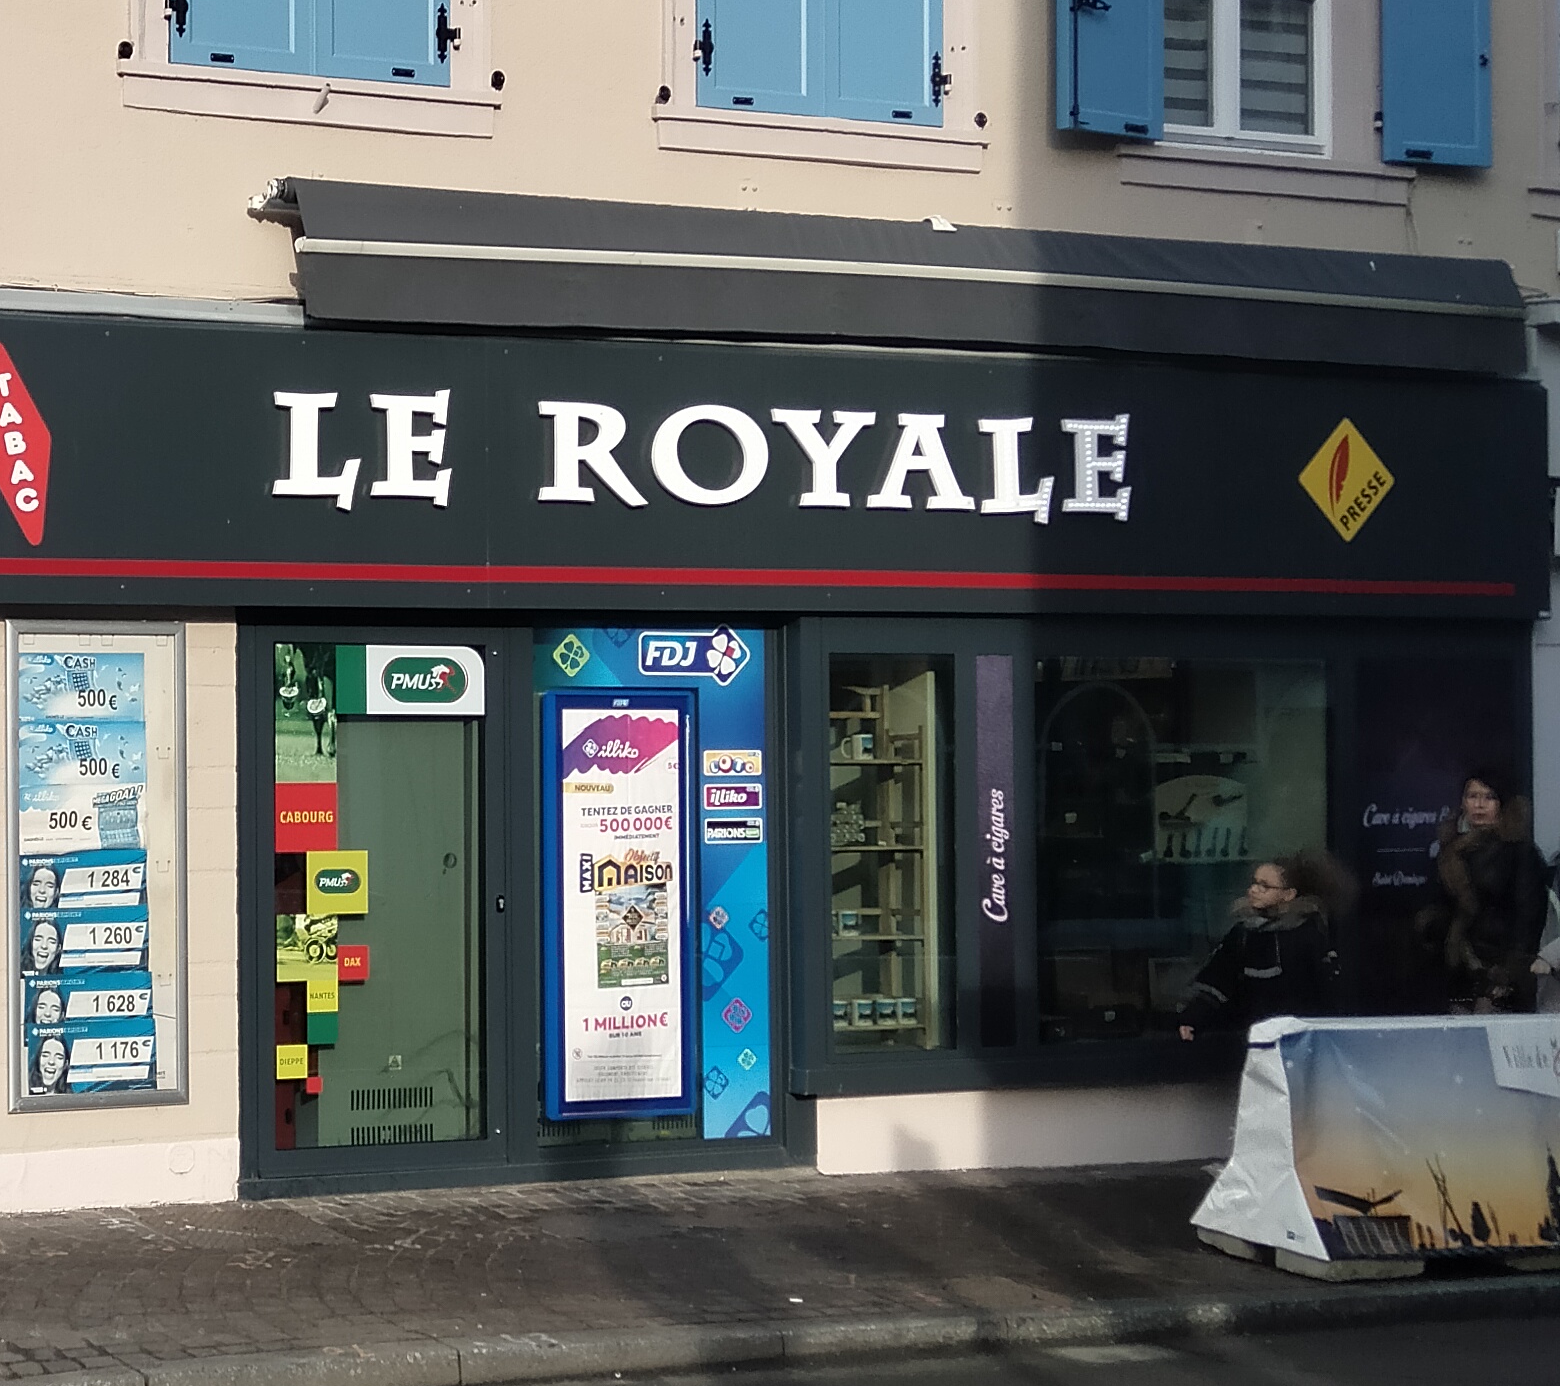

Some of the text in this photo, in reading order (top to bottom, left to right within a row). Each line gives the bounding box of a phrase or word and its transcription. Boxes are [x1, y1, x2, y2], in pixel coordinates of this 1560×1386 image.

[272, 388, 1133, 524] LE ROYALE
[1339, 471, 1387, 531] PRESSE
[645, 640, 698, 666] FDJ
[63, 655, 96, 669] CASH
[390, 673, 430, 690] PMU
[78, 689, 118, 710] 500 €
[65, 724, 98, 737] CASH
[598, 739, 639, 758] illiko
[79, 758, 120, 778] 500 €
[575, 784, 611, 792] NOUVEAU
[710, 789, 748, 805] illiko
[280, 811, 334, 823] CABOURG
[581, 804, 673, 816] TENTEZ DE GAGNER
[49, 811, 92, 830] 500 €
[985, 788, 1010, 853] cigares
[707, 827, 746, 839] PARIONS
[87, 871, 95, 888] 1
[101, 870, 130, 887] 284
[582, 855, 592, 891] MAXI
[319, 877, 340, 887] PMU
[982, 874, 1008, 922] Cave
[89, 927, 97, 945] 1
[103, 926, 132, 945] 260
[344, 957, 361, 967] DAX
[92, 995, 100, 1013] 1
[106, 994, 135, 1013] 628
[310, 992, 335, 1000] NANTES
[621, 1000, 632, 1008] OU
[582, 1018, 589, 1032] 1
[96, 1042, 103, 1060] 1
[110, 1040, 139, 1059] 176
[280, 1058, 304, 1066] DIEPPE
